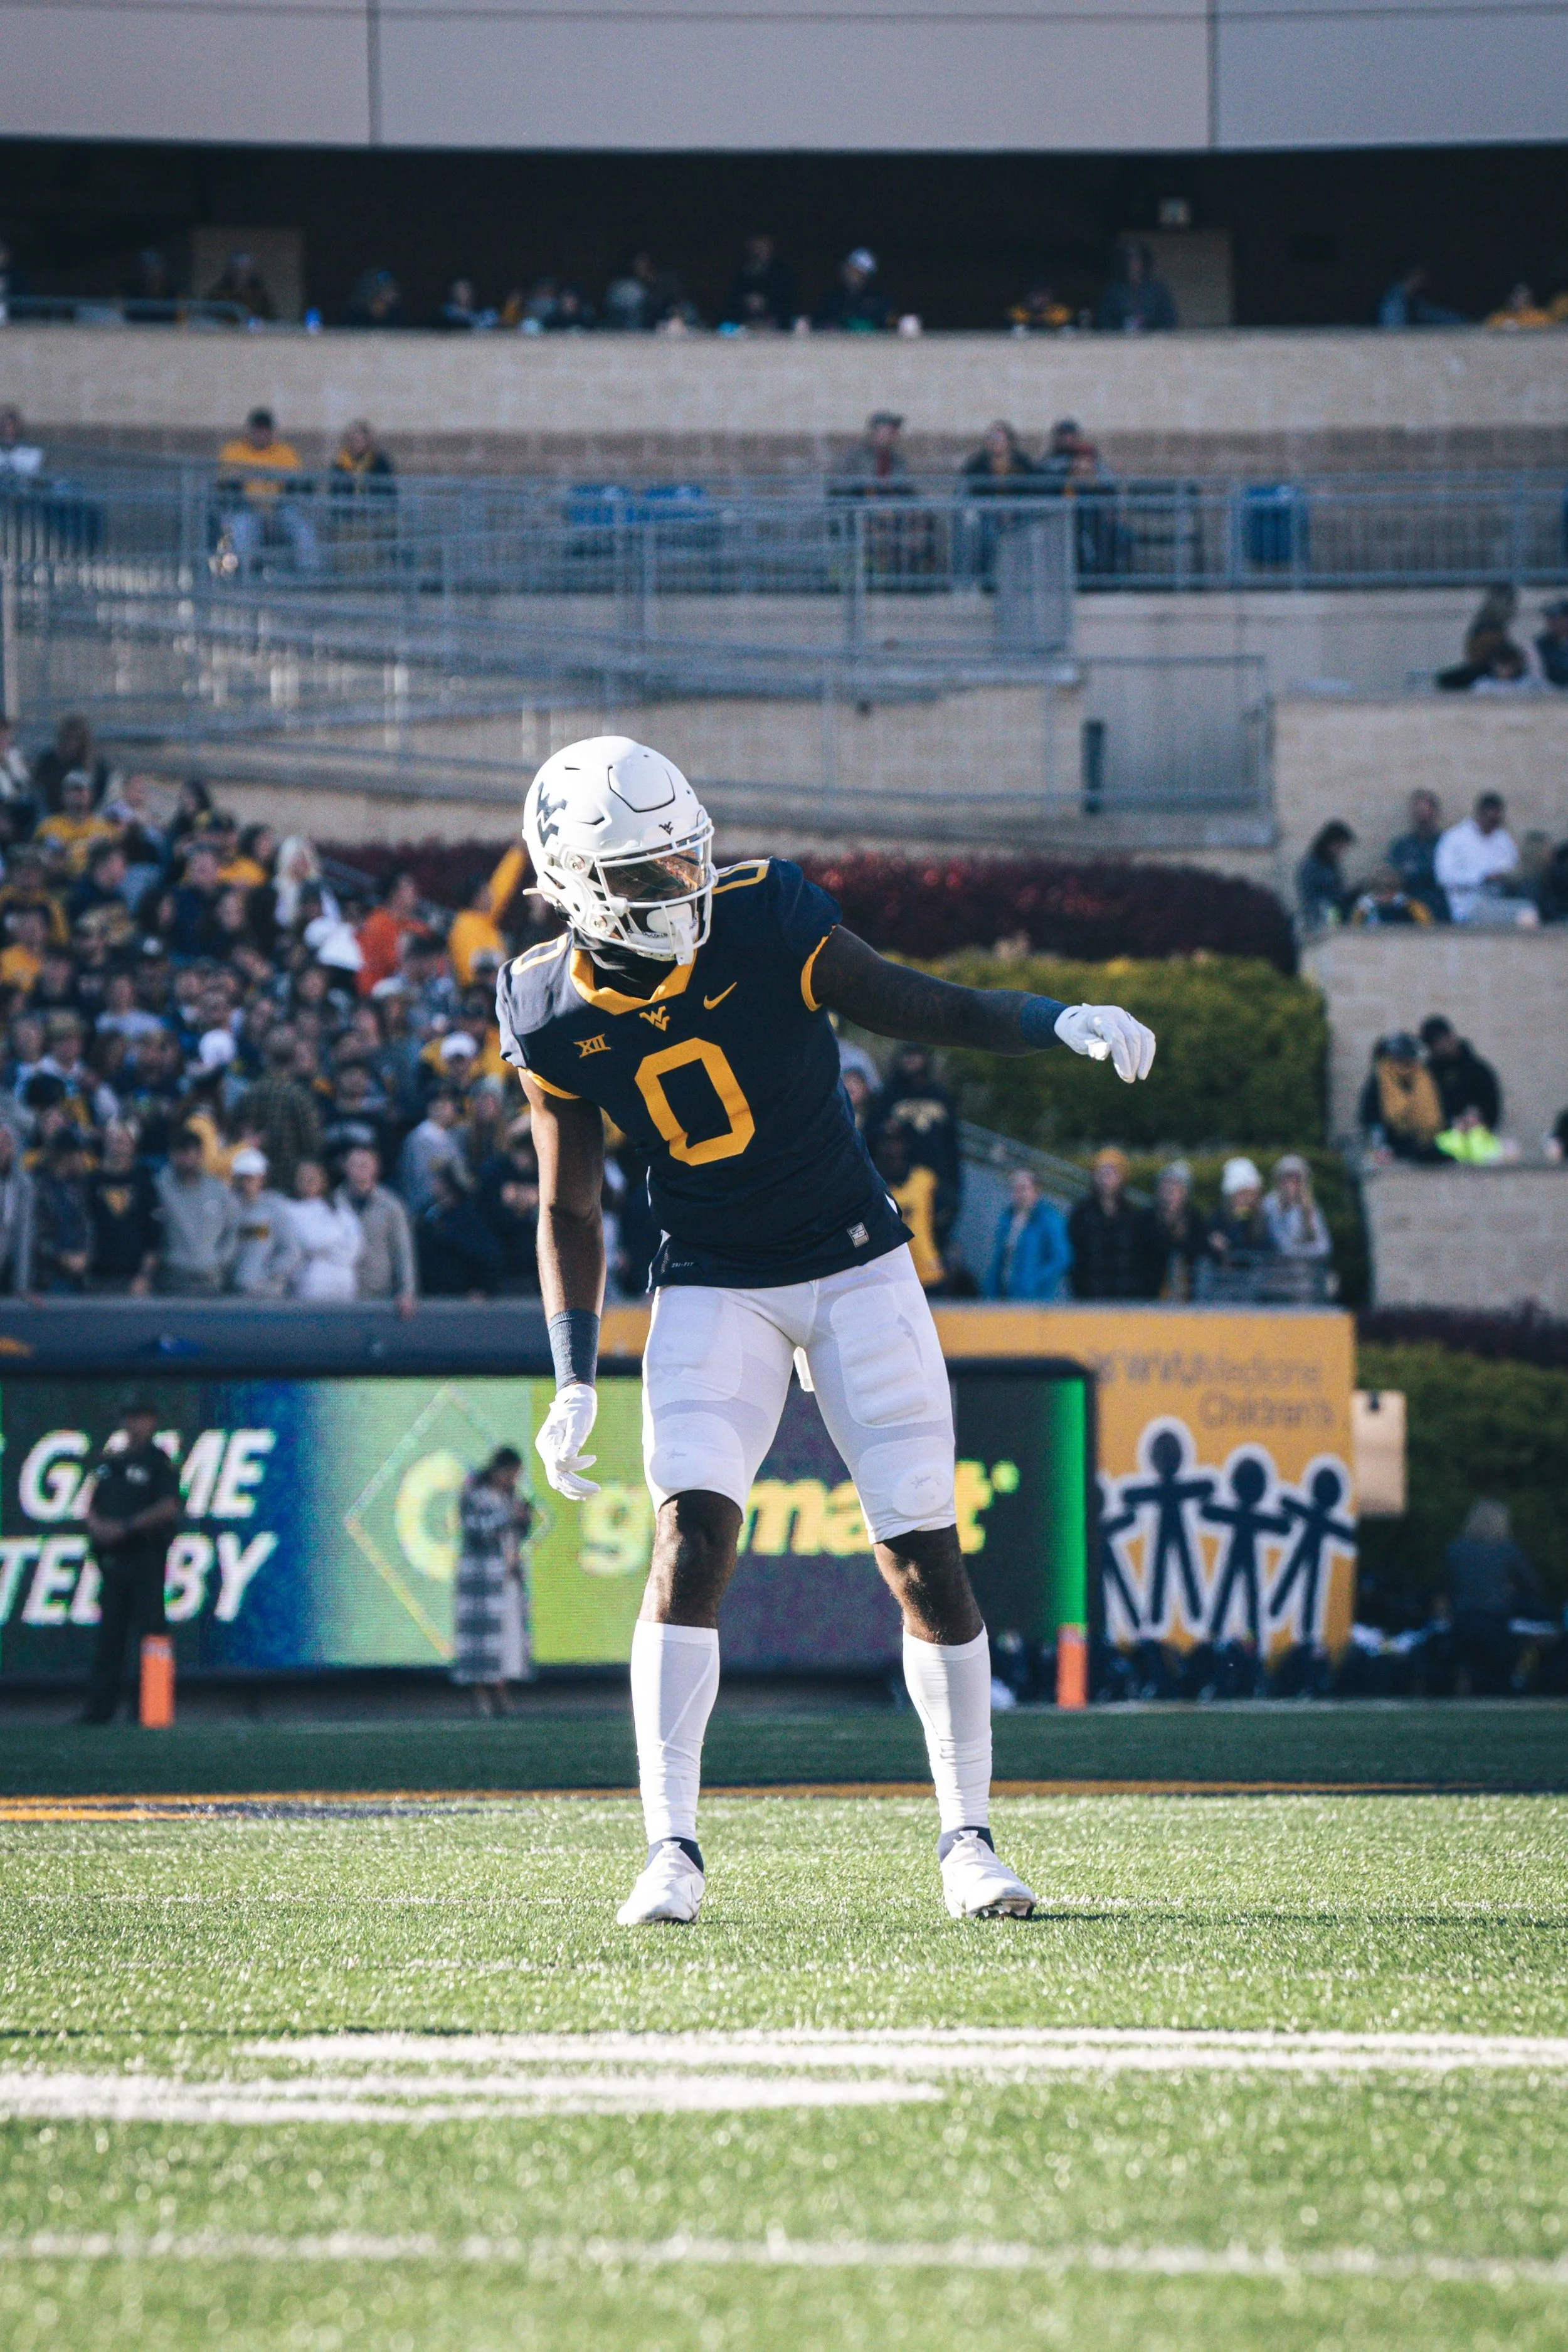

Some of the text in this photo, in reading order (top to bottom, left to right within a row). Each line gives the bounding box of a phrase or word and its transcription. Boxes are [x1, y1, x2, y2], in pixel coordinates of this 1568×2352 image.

[573, 1033, 612, 1059] XII
[635, 1037, 756, 1166] 0
[163, 1531, 279, 1623] BY
